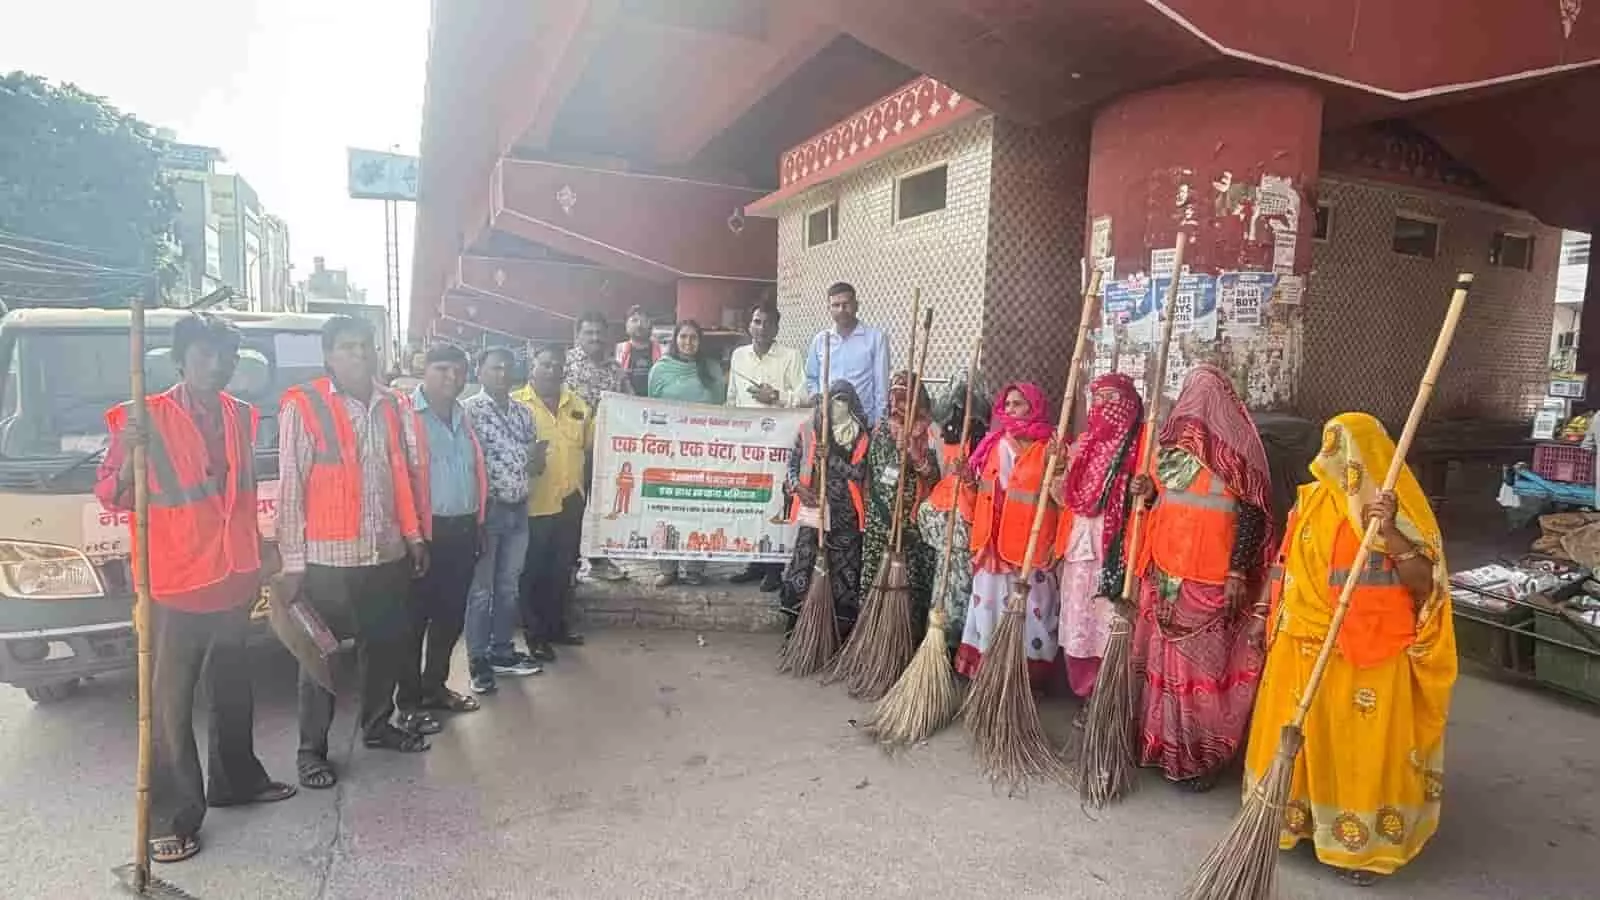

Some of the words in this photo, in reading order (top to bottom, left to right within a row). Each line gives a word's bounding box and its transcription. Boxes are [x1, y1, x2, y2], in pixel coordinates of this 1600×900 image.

[1236, 298, 1258, 307] BOYS
[612, 436, 638, 453] एक
[641, 433, 675, 457] दिन,
[680, 440, 705, 457] एक
[741, 445, 766, 461] एक
[767, 447, 792, 463] सा
